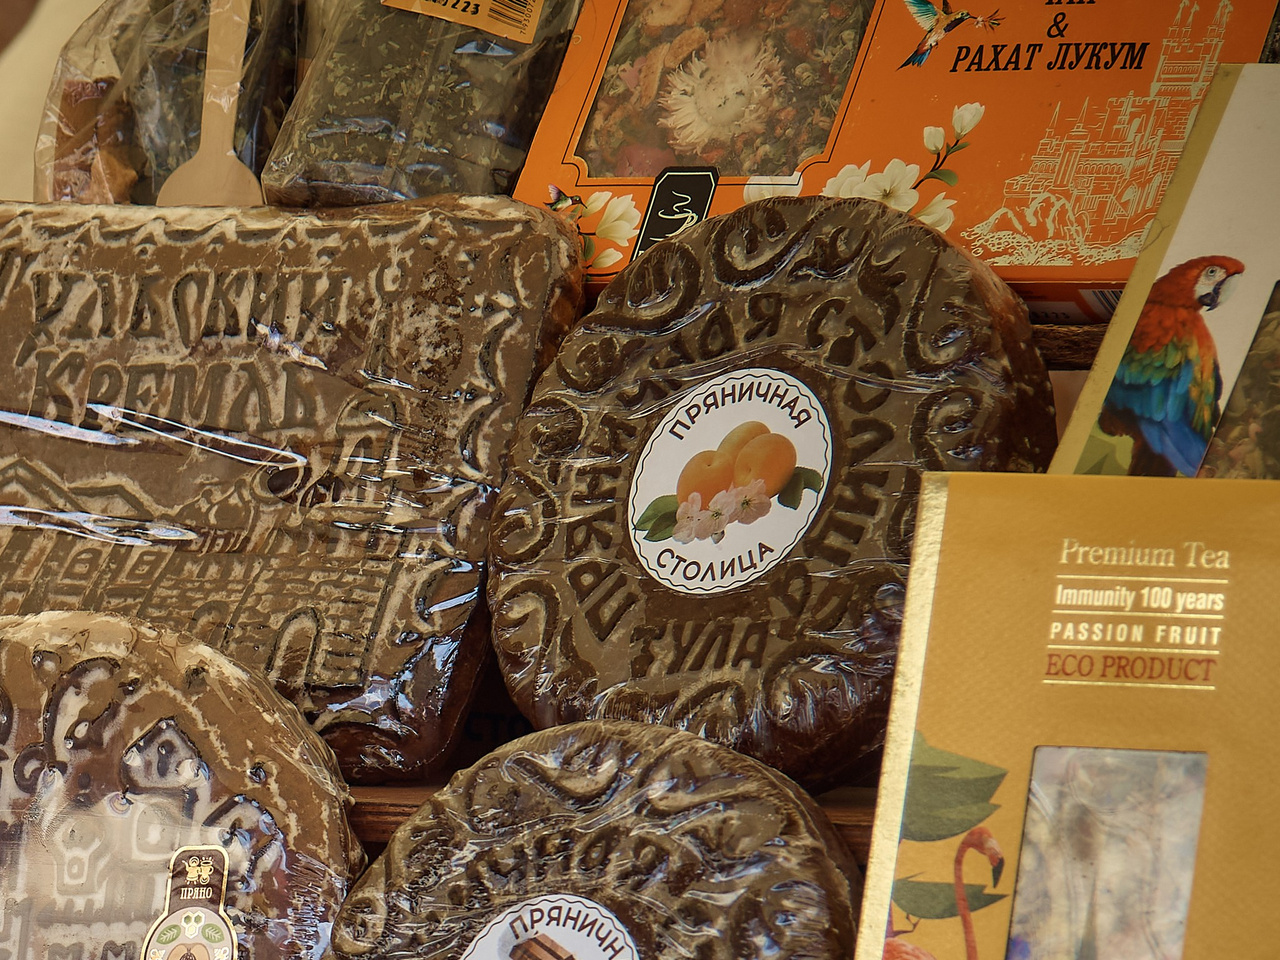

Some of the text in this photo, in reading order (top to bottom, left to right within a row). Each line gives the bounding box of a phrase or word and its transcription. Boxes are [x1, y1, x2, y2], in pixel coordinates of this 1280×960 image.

[949, 43, 1150, 72] РАХАТ ЛУКУМ
[668, 381, 812, 441] ПРЯНИЧНАЯ
[656, 541, 775, 583] СТОЛИЦА
[1058, 537, 1231, 569] Premium Tea
[1055, 584, 1225, 614] Immunity 100 years
[1049, 622, 1222, 646] PASSION FRUIT
[1045, 653, 1218, 682] ECO PRODUCT
[179, 886, 213, 900] ПРЯНО
